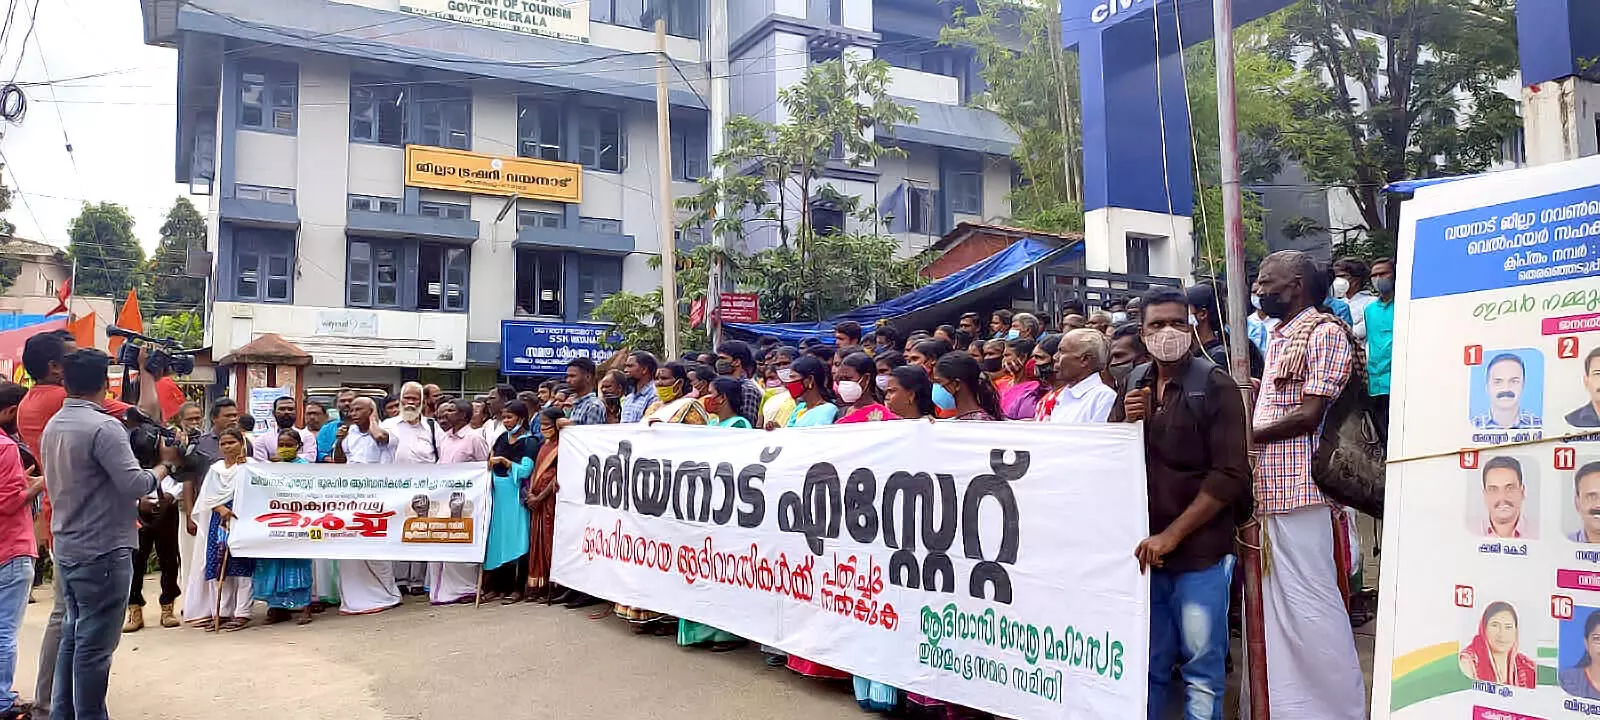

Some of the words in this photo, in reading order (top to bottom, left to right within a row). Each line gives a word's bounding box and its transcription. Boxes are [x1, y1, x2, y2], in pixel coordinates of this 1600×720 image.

[448, 1, 480, 15] GOVT
[483, 7, 497, 18] OF
[499, 10, 547, 27] KERALA
[522, 1, 571, 19] TOURISM
[507, 173, 573, 188] വയനാട്
[1445, 216, 1498, 240] വയനാട്
[1501, 212, 1536, 231] ജില്ലാ
[1554, 220, 1600, 241] സഹക
[1468, 347, 1476, 364] 1
[1563, 339, 1576, 357] 2
[1463, 451, 1475, 467] 9
[1556, 449, 1573, 468] 11
[585, 440, 783, 528] മരിയനാട്
[310, 529, 322, 540] 20
[1456, 588, 1472, 606] 13
[1553, 600, 1571, 618] 16
[920, 602, 995, 647] ആദിവാസി
[1012, 666, 1063, 705] സമിതി
